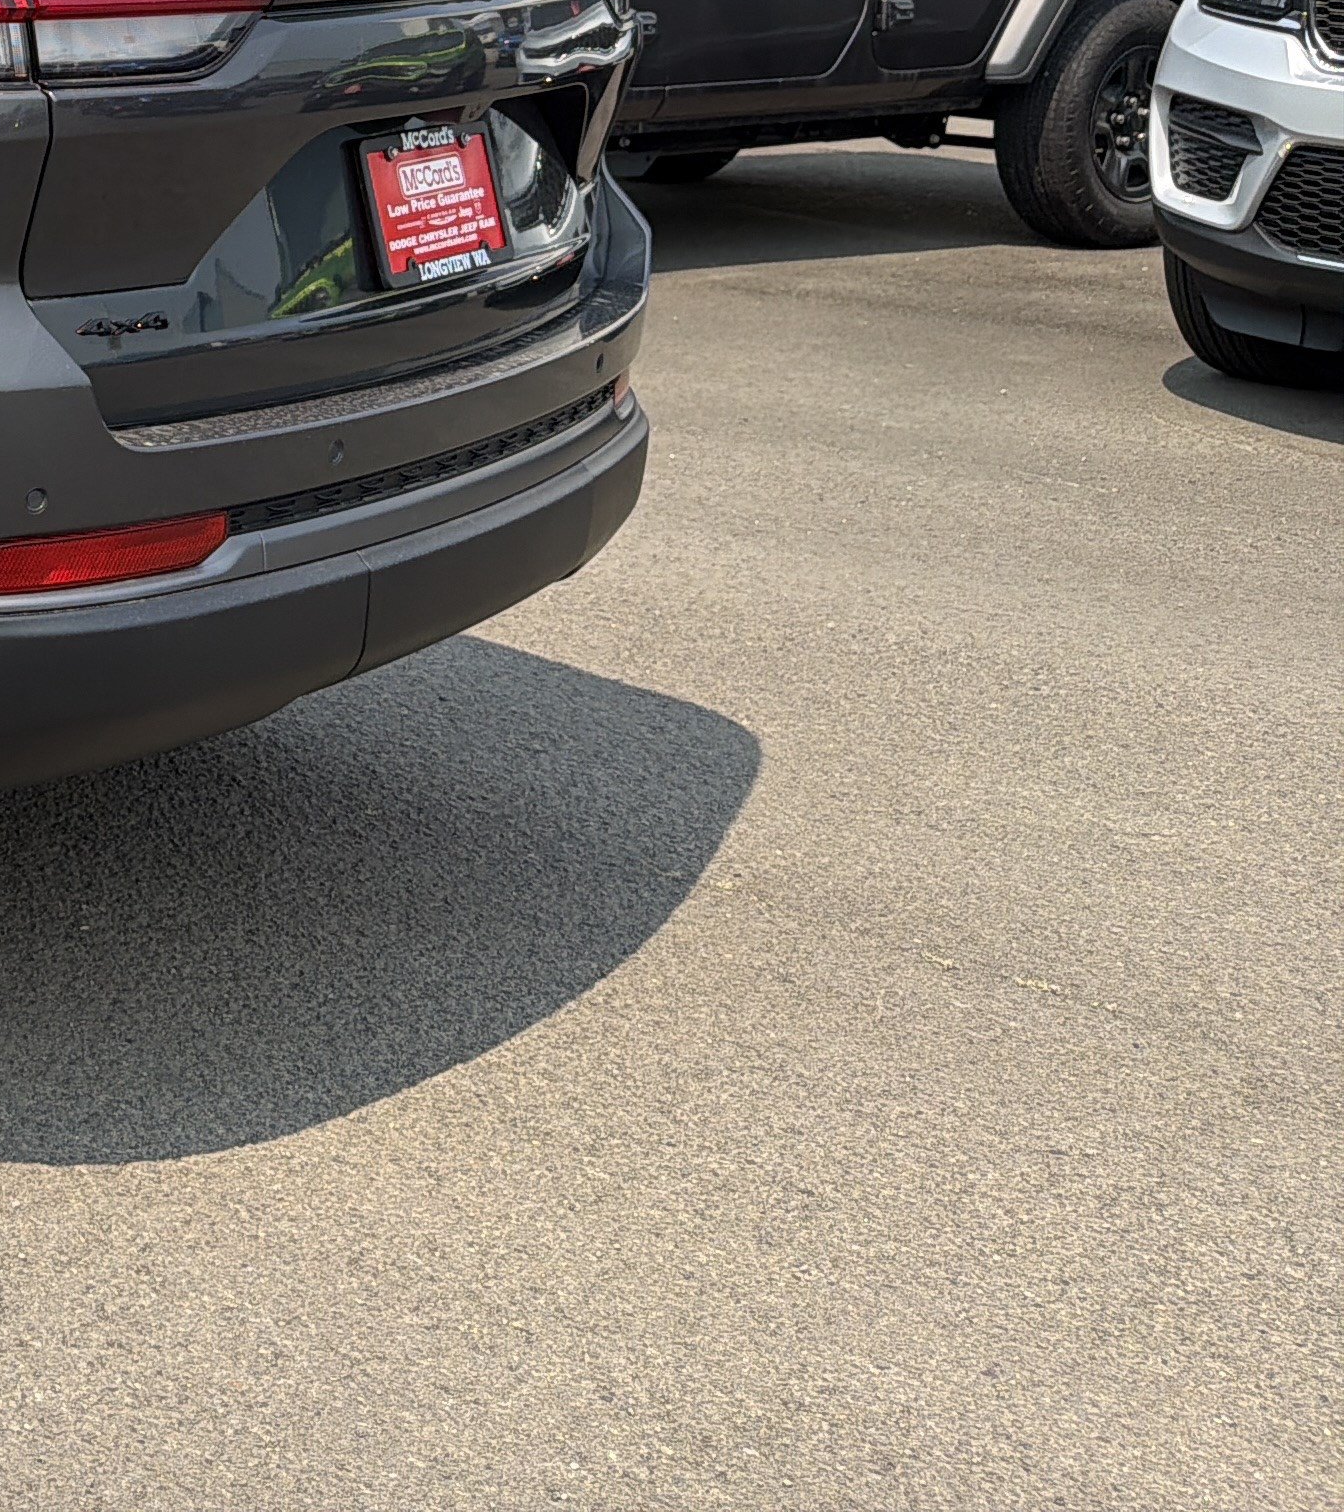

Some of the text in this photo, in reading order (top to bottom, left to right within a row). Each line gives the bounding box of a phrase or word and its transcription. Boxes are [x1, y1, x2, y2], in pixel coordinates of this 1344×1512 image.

[402, 161, 460, 191] McCord's
[387, 187, 485, 218] Low Price Guarantee
[389, 236, 418, 252] DODGE
[419, 226, 459, 244] CHRYSLER
[460, 221, 478, 234] JEEP
[478, 217, 496, 229] RAM
[418, 248, 492, 281] LONGVIEW WA
